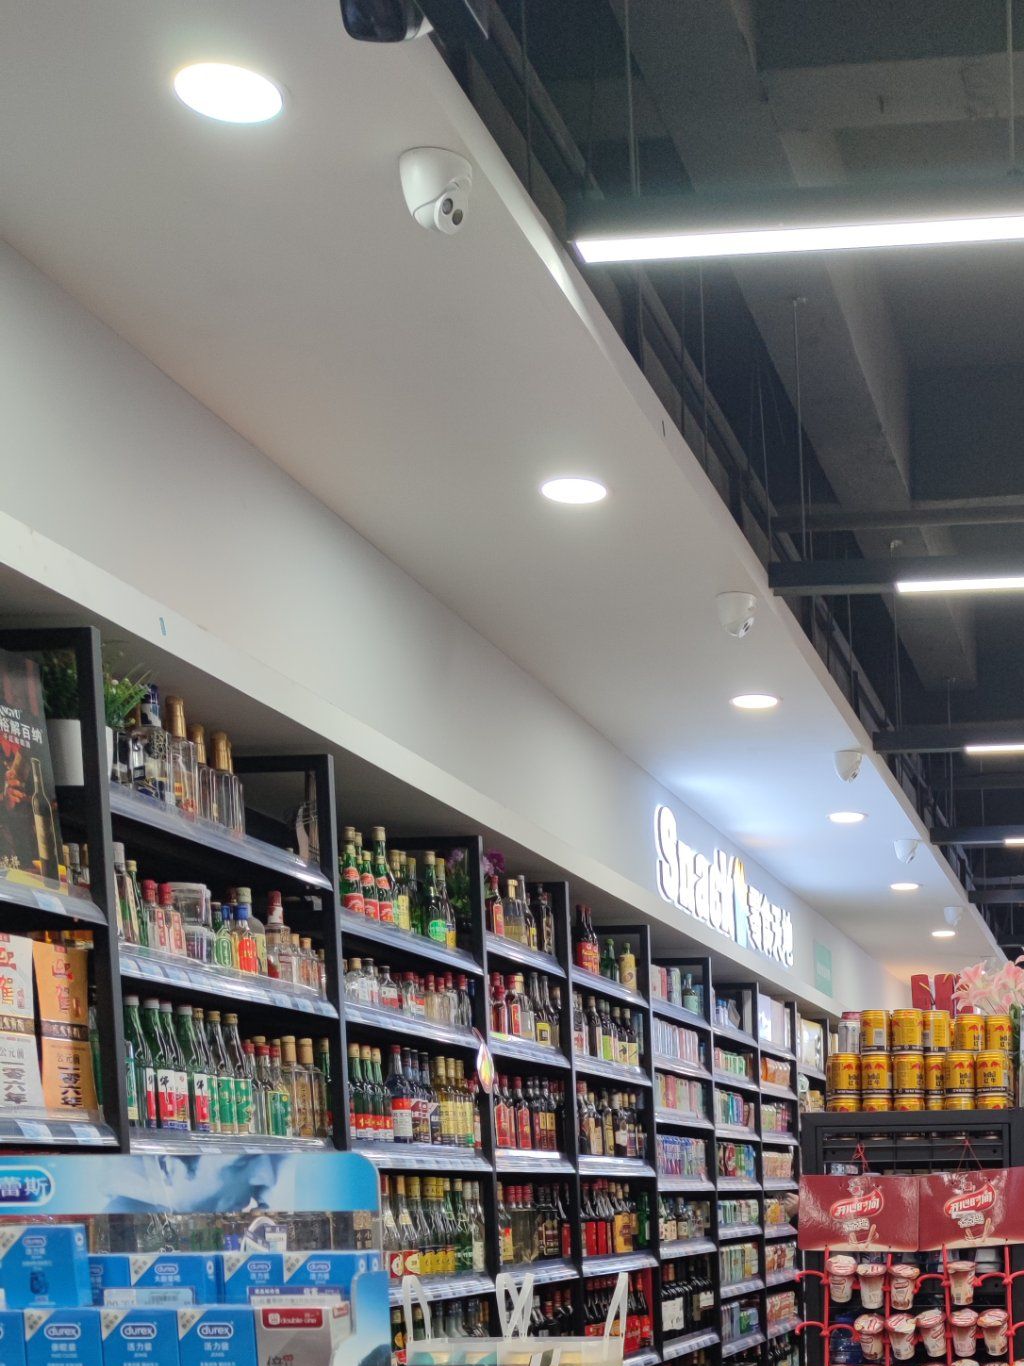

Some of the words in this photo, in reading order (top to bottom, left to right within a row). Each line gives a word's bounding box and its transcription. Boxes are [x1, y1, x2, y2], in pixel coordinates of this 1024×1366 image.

[656, 805, 736, 940] Snack
[48, 1326, 77, 1336] durex
[124, 1326, 153, 1336] durex
[201, 1325, 230, 1336] durex
